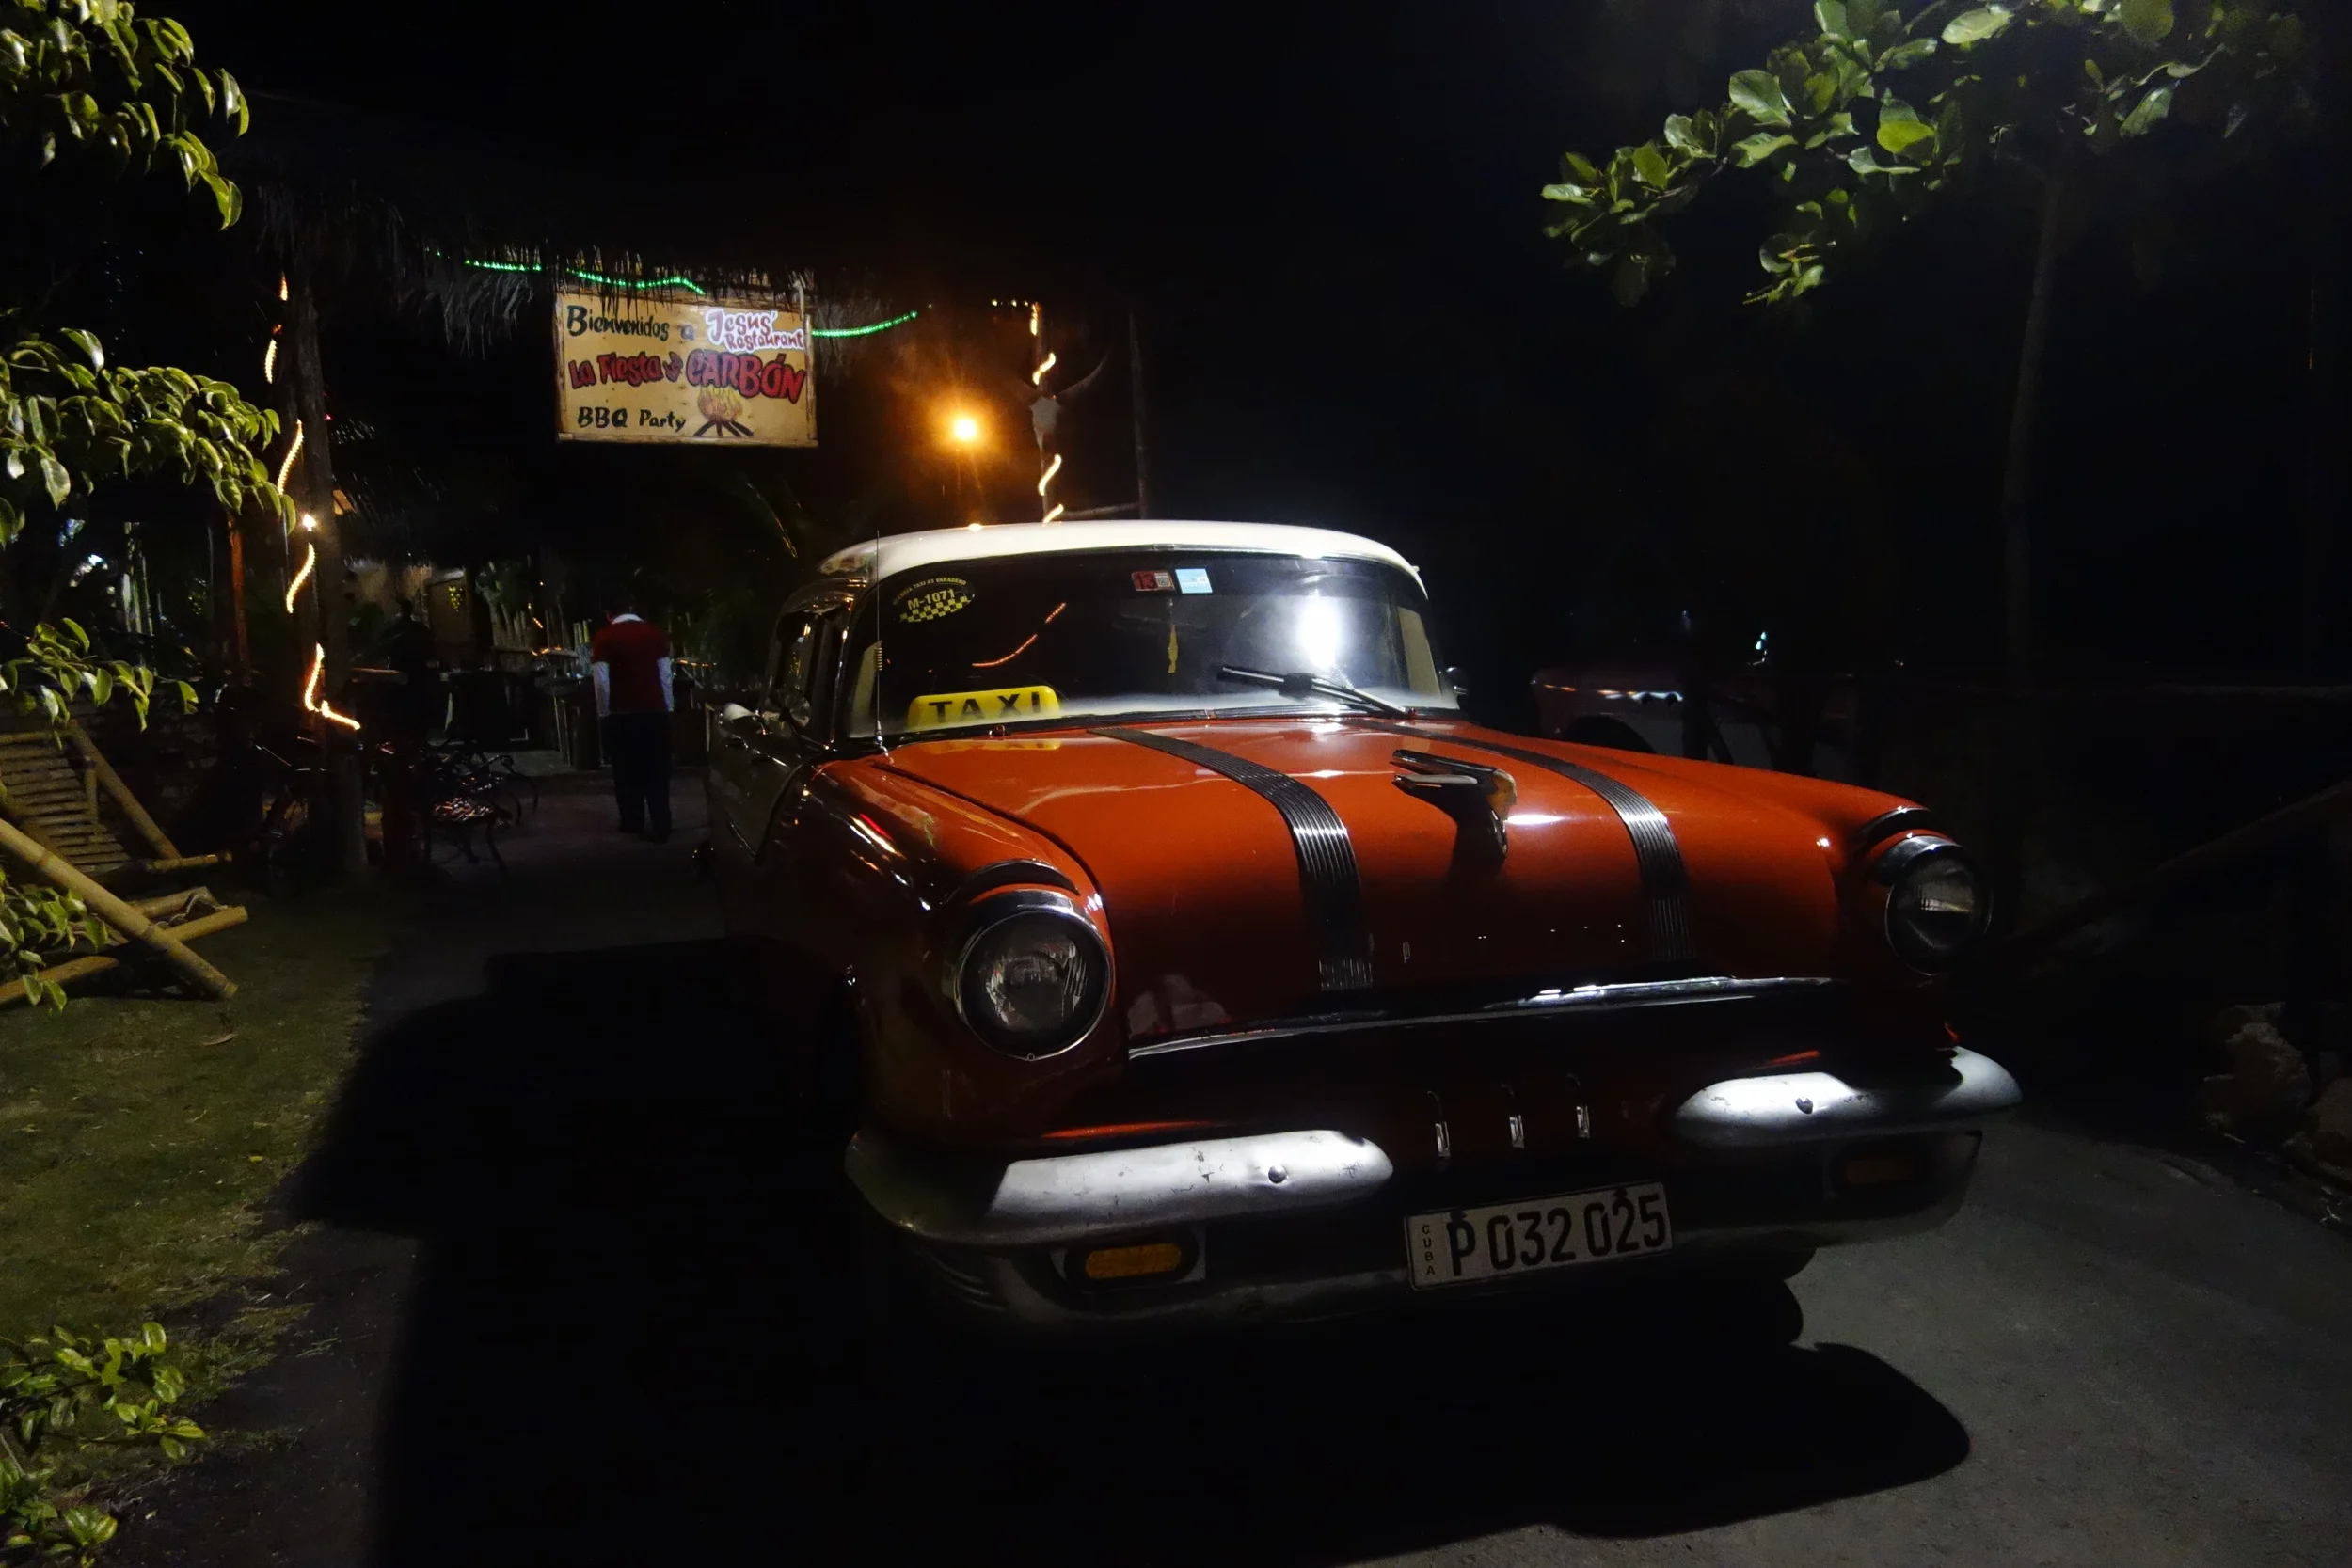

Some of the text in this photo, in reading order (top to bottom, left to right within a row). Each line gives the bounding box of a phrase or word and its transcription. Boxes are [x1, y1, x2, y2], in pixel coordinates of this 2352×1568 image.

[566, 304, 695, 341] Bienvenidos a
[725, 330, 803, 350] Restaurant
[597, 351, 663, 387] Fiesta
[577, 406, 687, 433] BBQ Party
[907, 589, 955, 610] M-1071
[928, 691, 1041, 723] TAXI
[1486, 1207, 1576, 1270] 032
[1583, 1193, 1666, 1258] 025
[1422, 1224, 1436, 1275] CUBA
